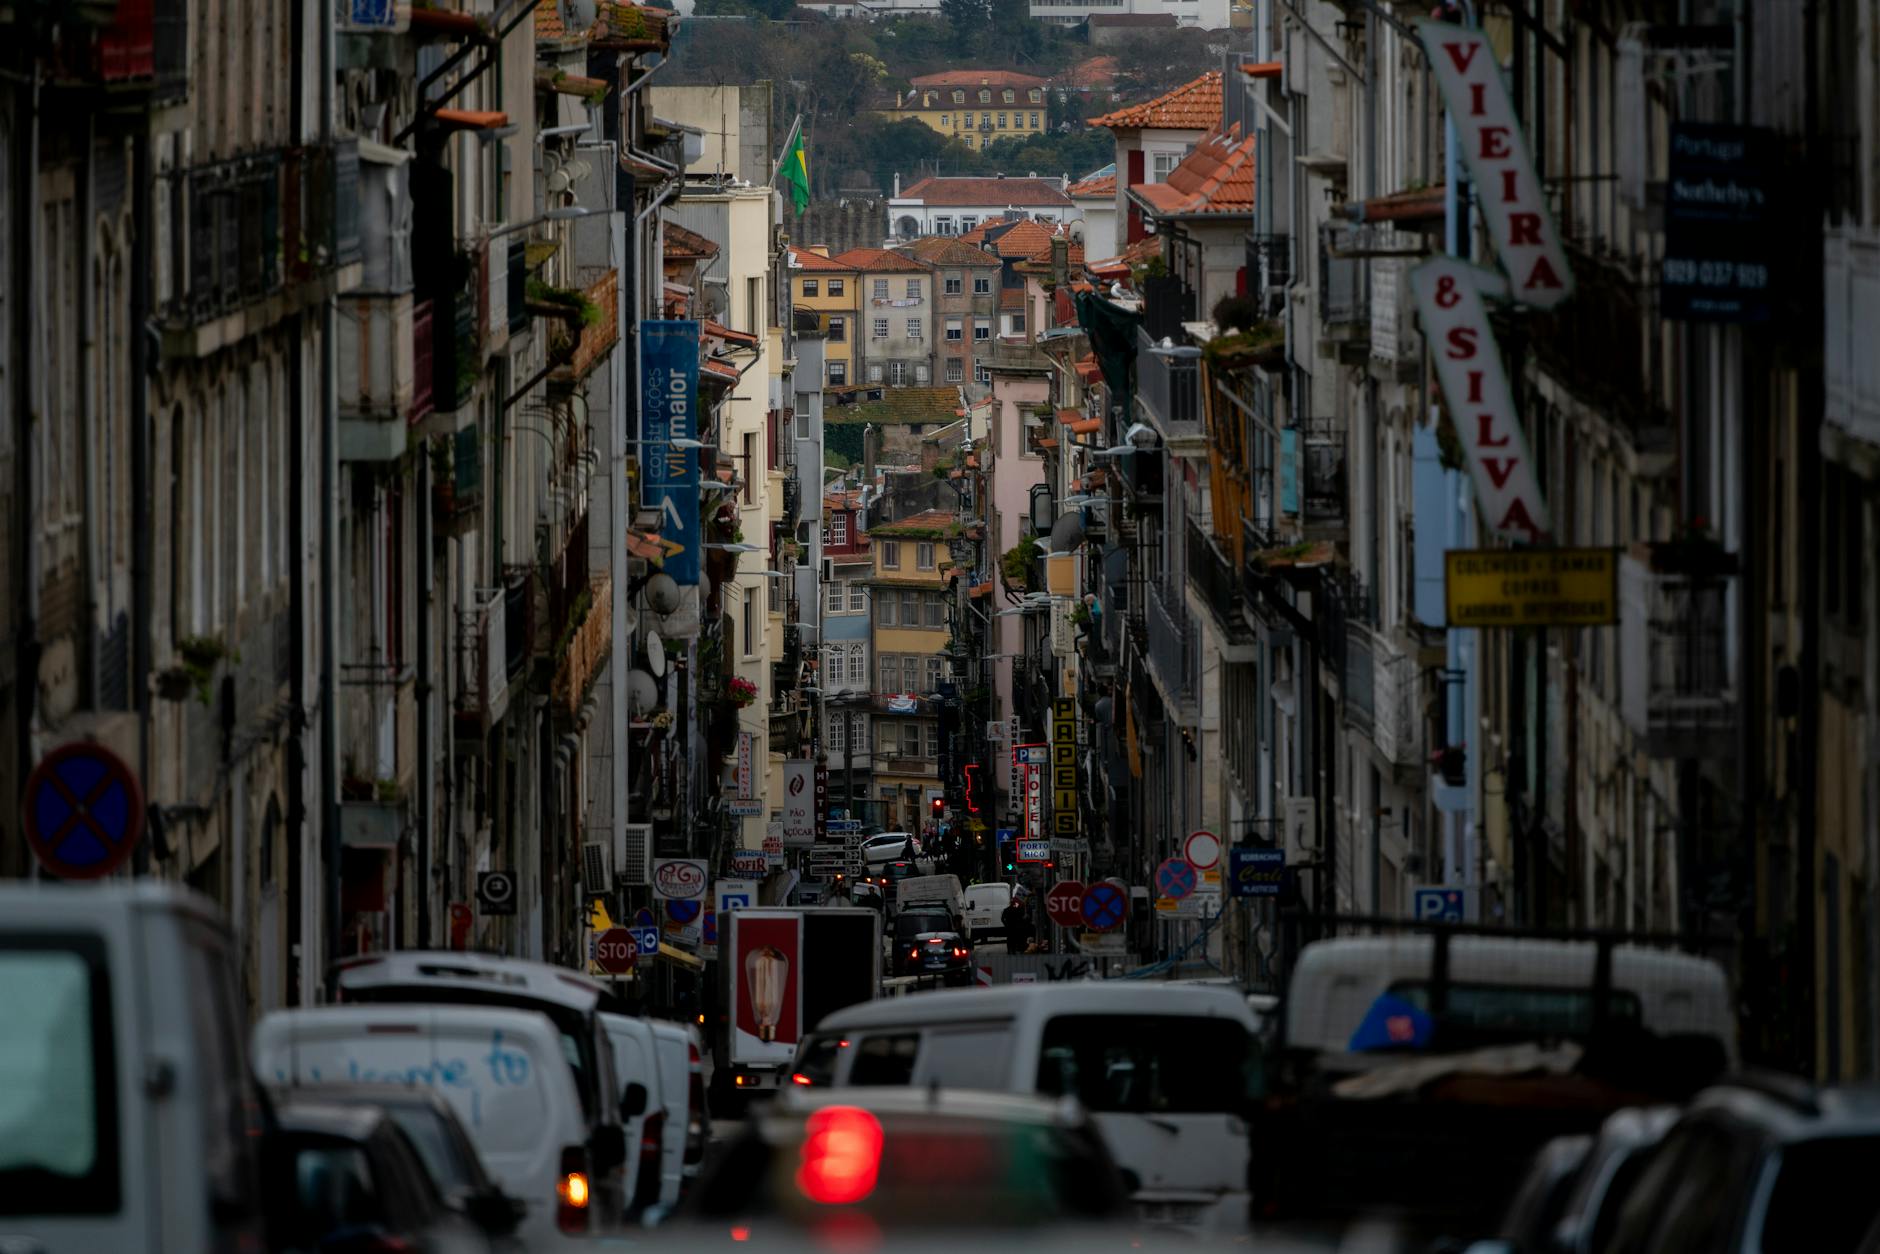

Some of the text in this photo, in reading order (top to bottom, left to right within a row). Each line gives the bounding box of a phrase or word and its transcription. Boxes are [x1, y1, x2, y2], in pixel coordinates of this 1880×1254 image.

[1443, 42, 1563, 288] VIEIRA
[1435, 273, 1541, 540] & SILVA
[1019, 749, 1028, 761] P
[1057, 701, 1074, 832] PAPEIS
[789, 808, 805, 817] PÃO
[816, 772, 825, 835] HOTEL
[1029, 765, 1039, 838] HOTEL
[784, 826, 814, 837] AÇÚCAR
[1048, 896, 1081, 912] STO
[1420, 893, 1445, 920] P
[599, 942, 638, 960] STOP
